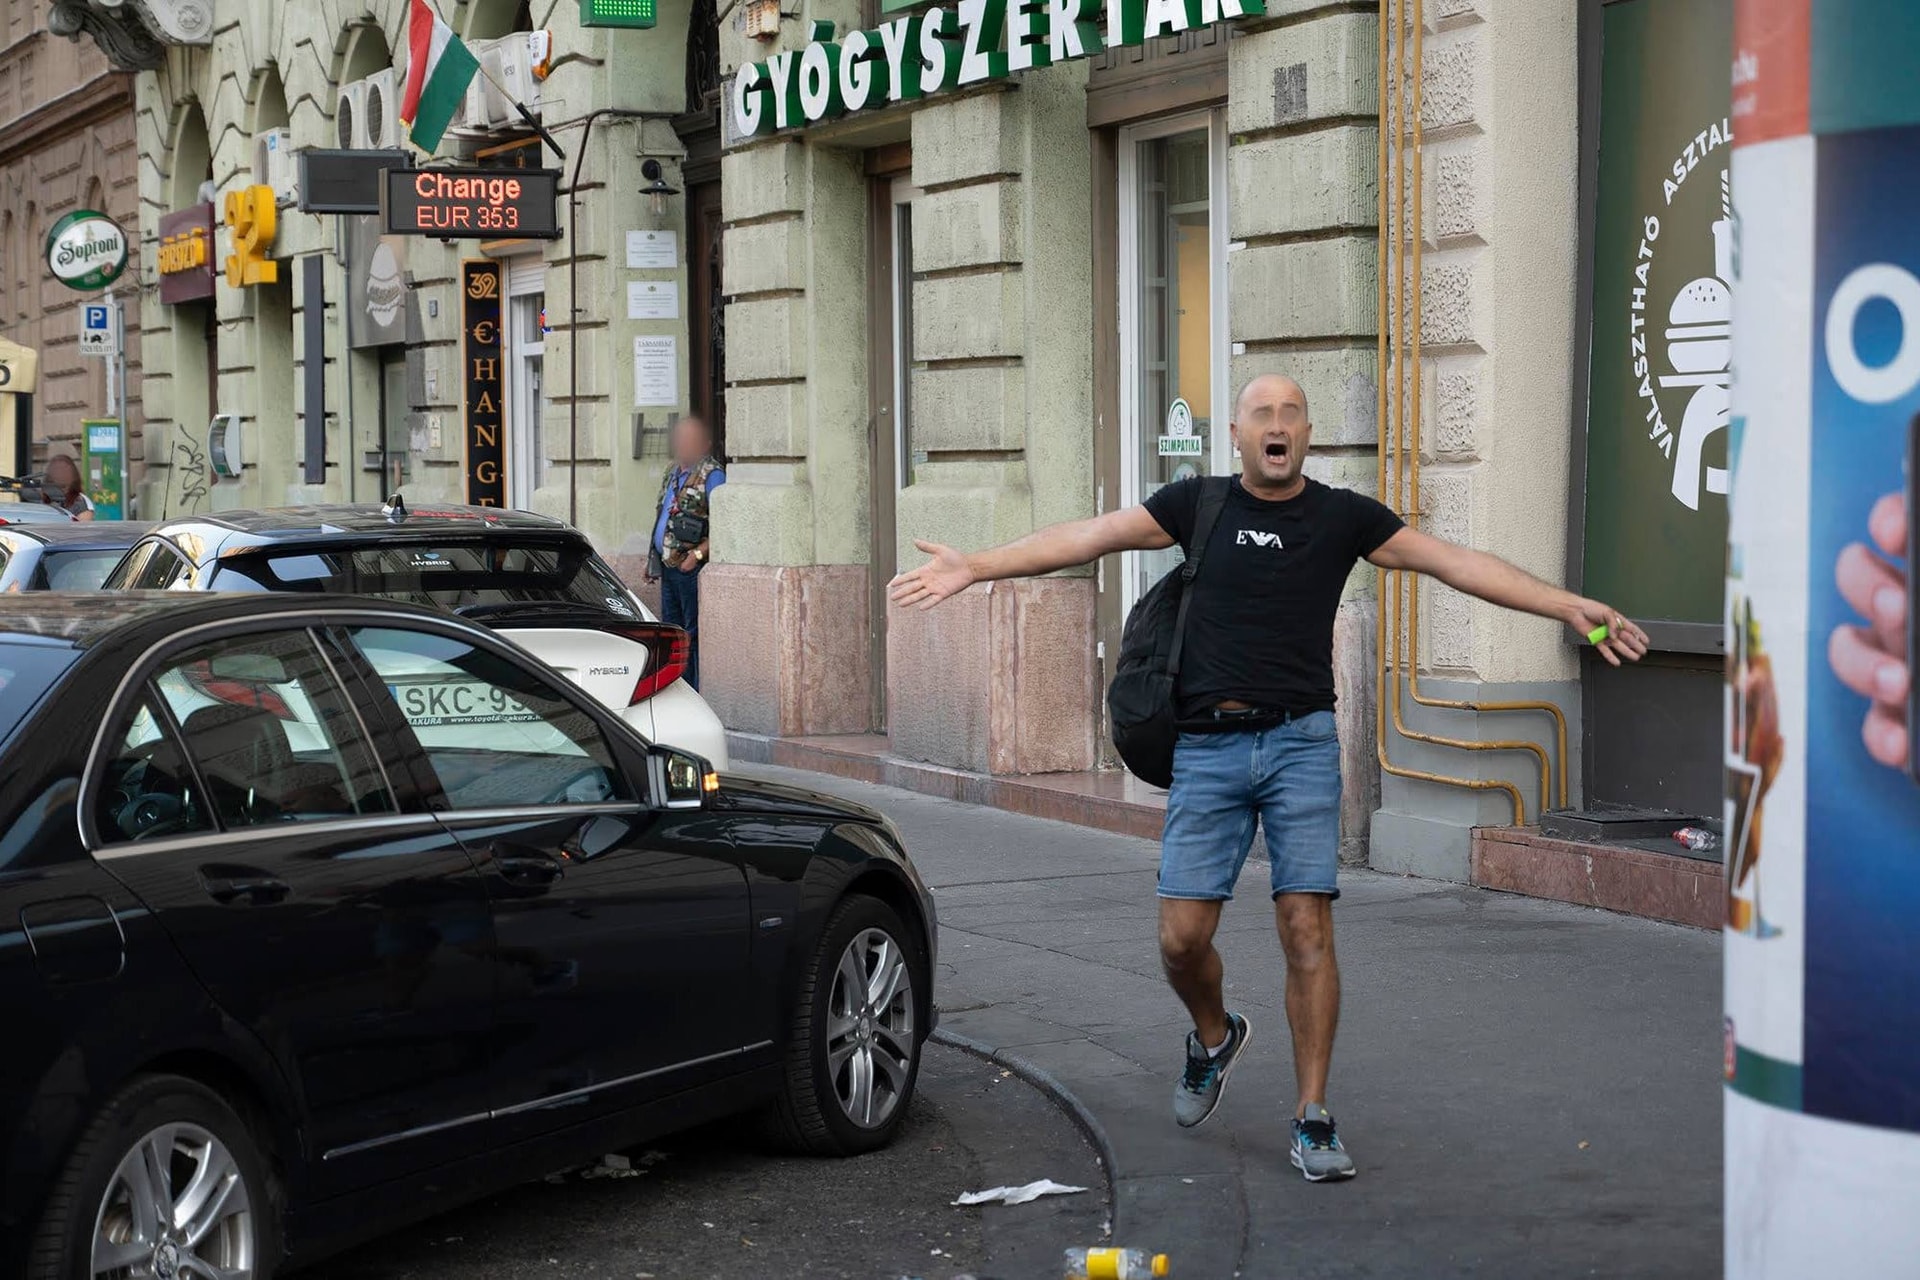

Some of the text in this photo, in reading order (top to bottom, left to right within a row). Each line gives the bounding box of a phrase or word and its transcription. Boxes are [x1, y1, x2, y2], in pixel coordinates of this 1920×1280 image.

[734, 0, 1246, 136] GYÓGYSZER
[415, 172, 521, 206] Change
[416, 205, 519, 228] EUR 353
[57, 233, 118, 267] Soproni
[90, 308, 104, 327] P
[1631, 215, 1673, 459] VÁLASZTHATÓ
[1160, 438, 1200, 452] SZIMPATIKA
